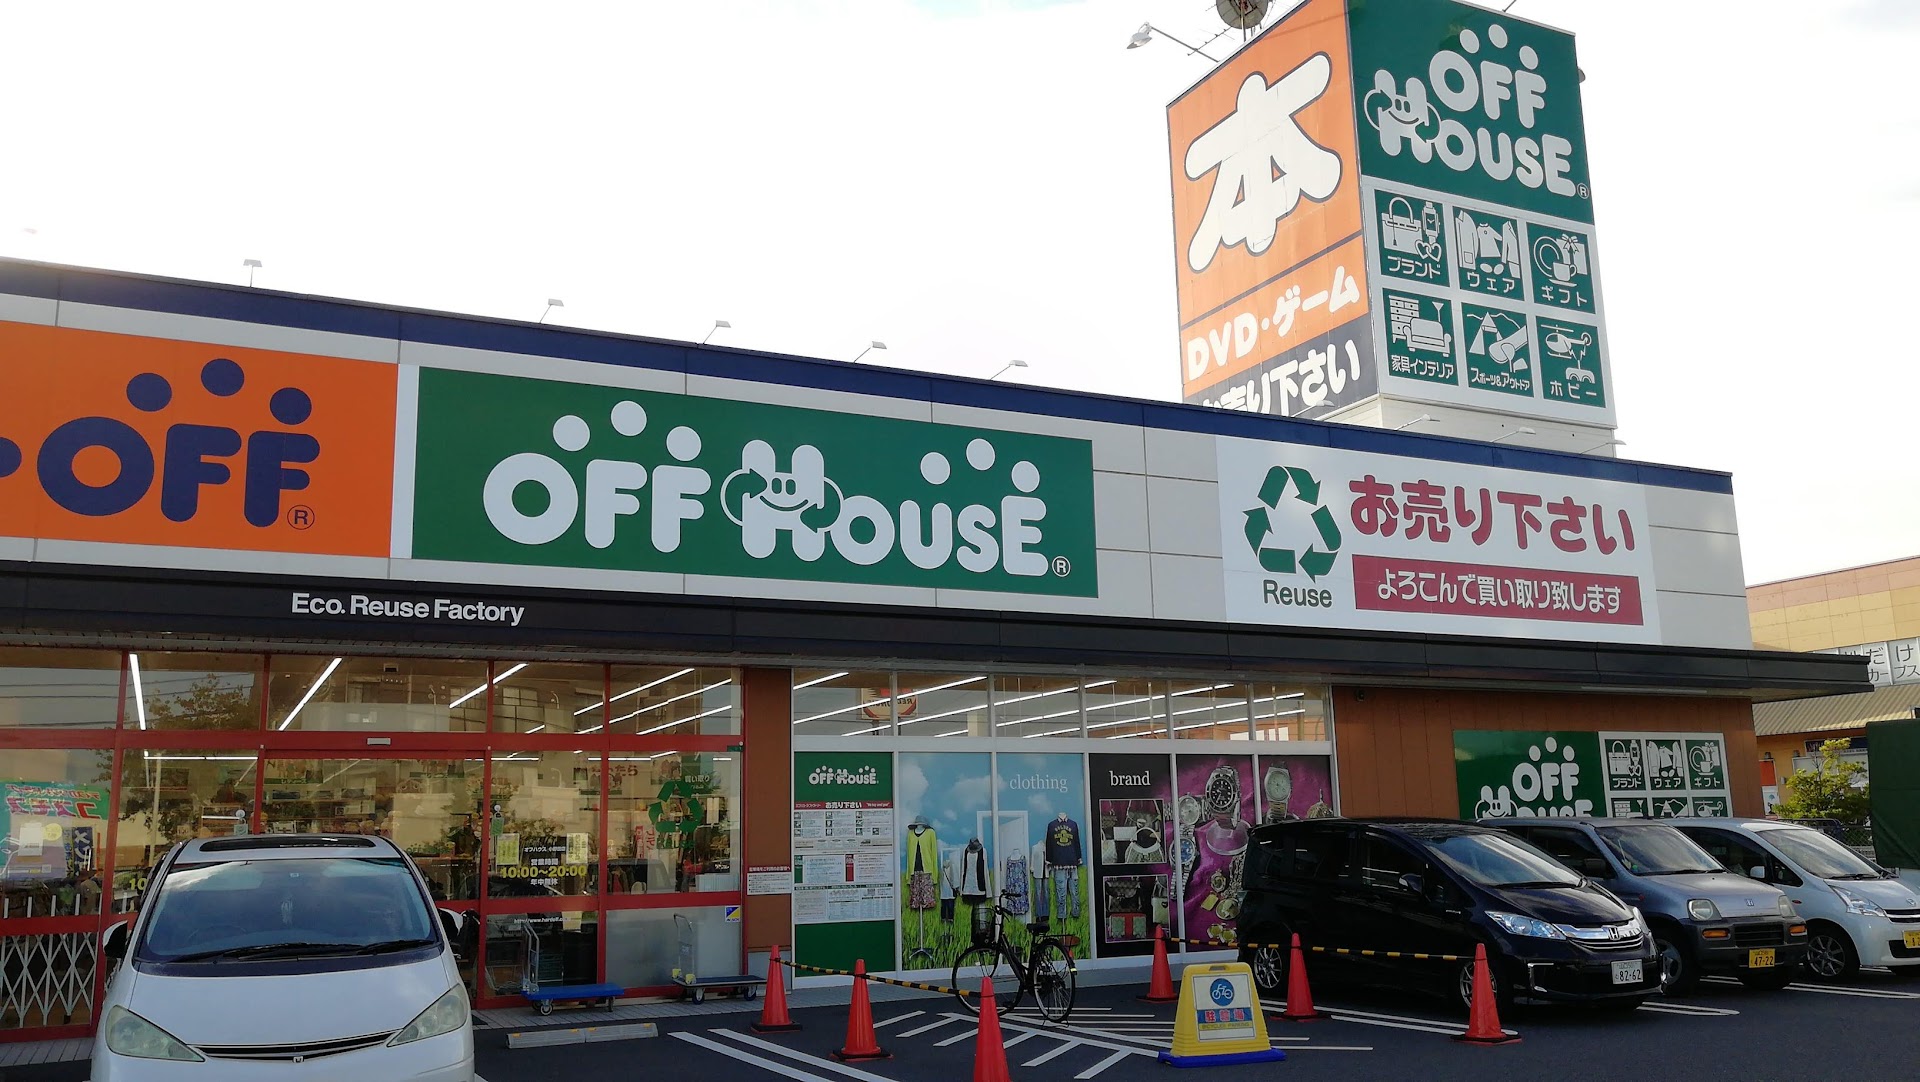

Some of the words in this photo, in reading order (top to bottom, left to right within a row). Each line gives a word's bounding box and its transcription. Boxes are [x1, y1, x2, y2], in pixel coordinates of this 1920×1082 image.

[1429, 49, 1547, 129] OFF
[1365, 69, 1576, 197] HOUSE
[1185, 52, 1342, 274] 本
[1387, 255, 1441, 279] ブランド
[1541, 284, 1588, 307] ギフト
[1391, 354, 1454, 379] 家具インテリア
[1550, 380, 1597, 399] ホビー
[482, 452, 712, 554] OFF
[721, 438, 1049, 578] HOUSE
[1348, 473, 1636, 556] お売り下さい
[1263, 579, 1333, 609] Reuse
[1377, 567, 1623, 616] よろこんで買い取り致します
[291, 592, 346, 615] Eco.
[350, 594, 430, 618] Reuse
[433, 598, 525, 627] Factory
[808, 772, 834, 785] OFF
[834, 768, 877, 785] HOUSE
[1009, 773, 1069, 793] clothing
[1108, 769, 1152, 786] brand
[1512, 762, 1580, 802] OFF
[1613, 777, 1642, 788] ブランド
[1694, 776, 1721, 788] ギフト
[825, 801, 862, 809] お売り下さい
